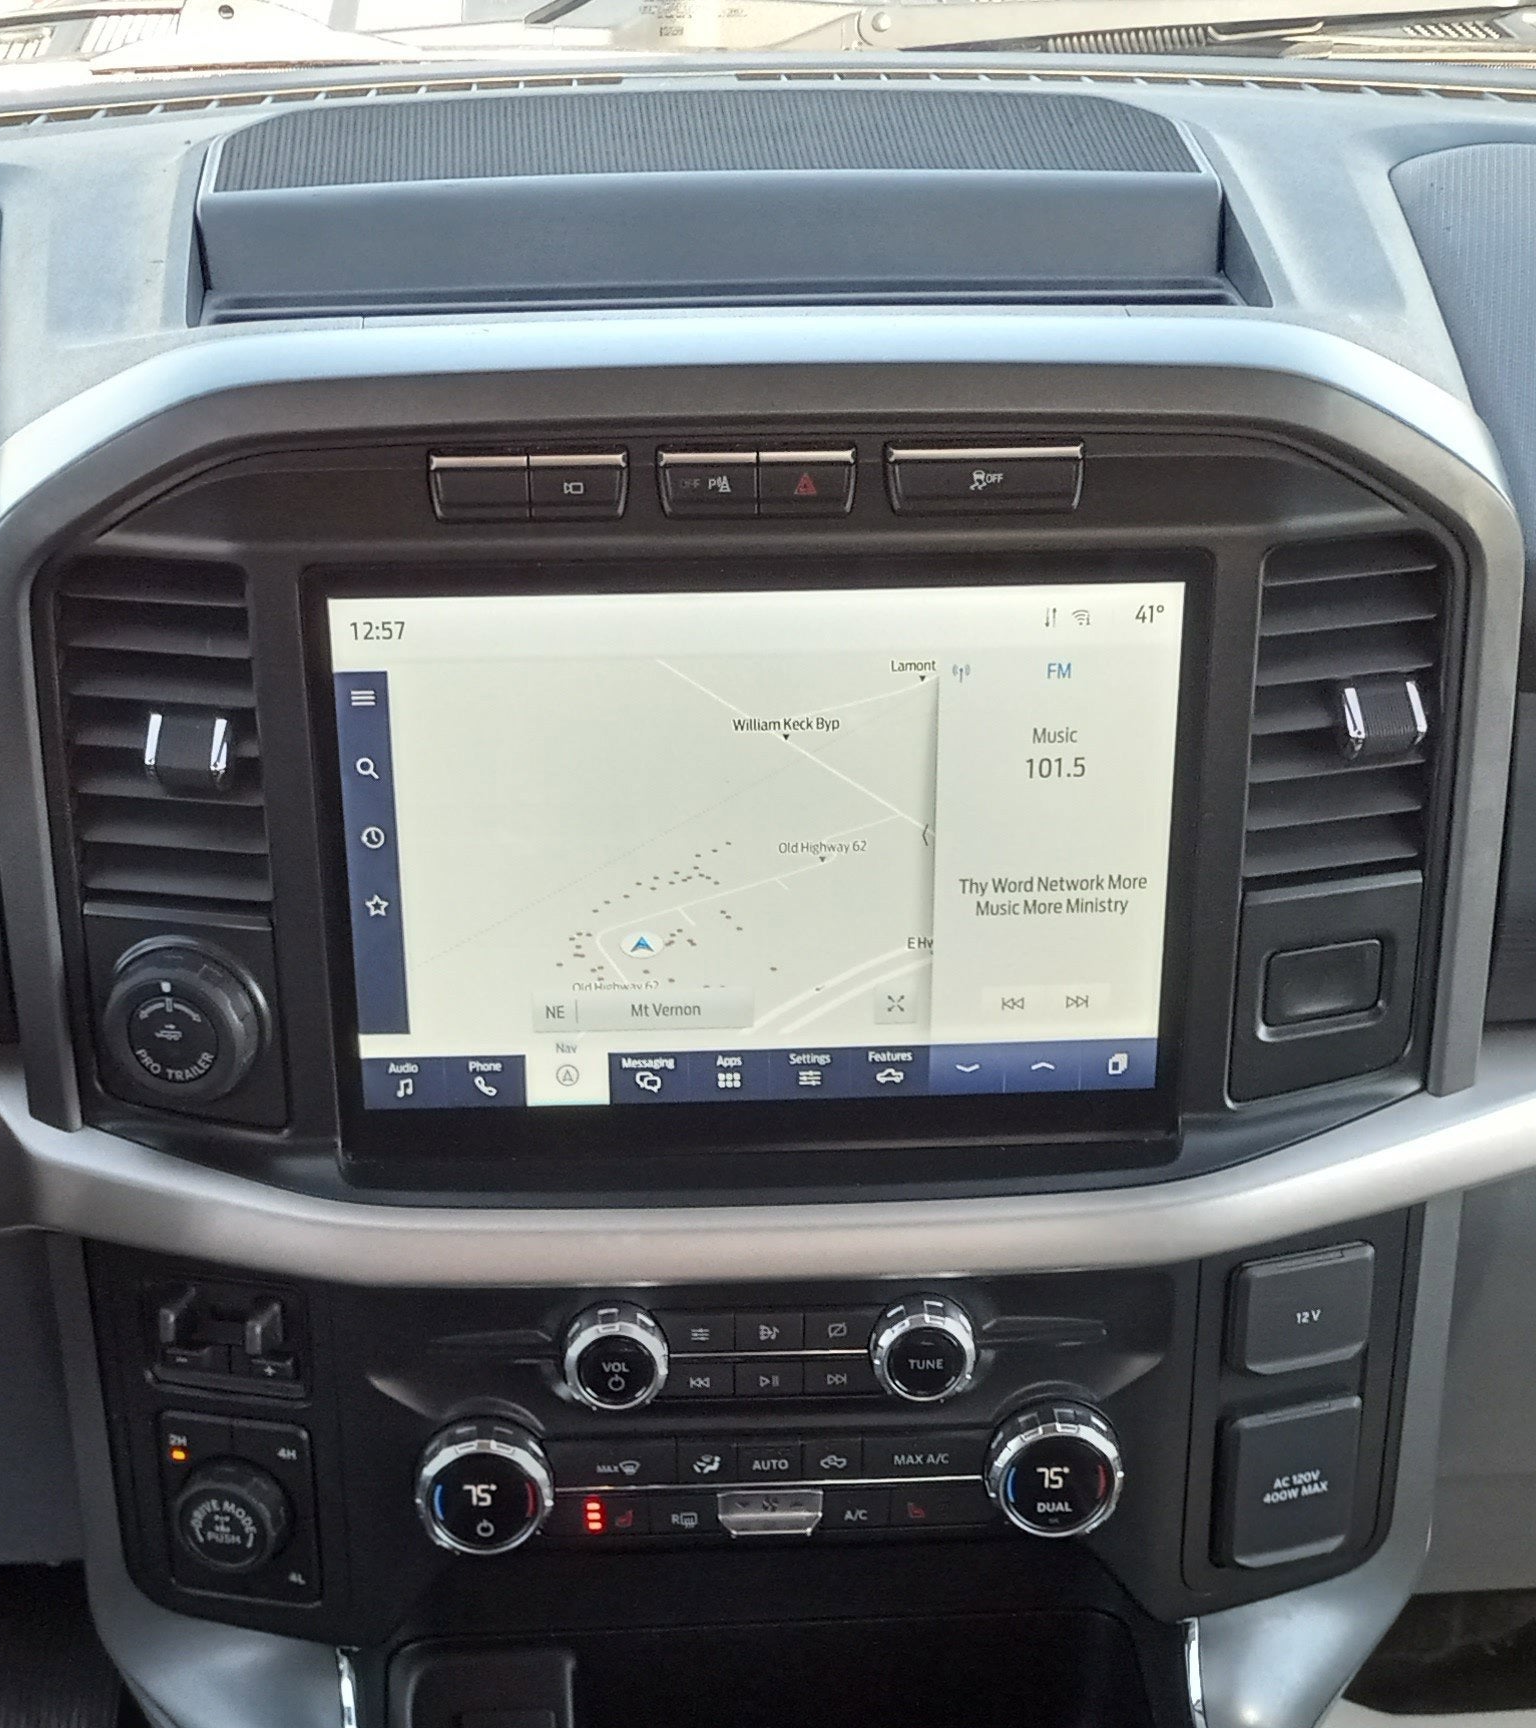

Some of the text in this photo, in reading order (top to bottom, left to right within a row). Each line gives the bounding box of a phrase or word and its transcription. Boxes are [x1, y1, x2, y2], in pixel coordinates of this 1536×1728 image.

[986, 473, 1004, 484] OFF
[1134, 604, 1166, 624] 41°
[350, 621, 405, 640] 12:57
[890, 660, 937, 673] Lamont
[1046, 662, 1073, 680] FM
[733, 717, 840, 733] William Keck Byp
[1032, 727, 1078, 745] Music
[1025, 757, 1086, 780] 101.5
[778, 841, 867, 856] Old Highway 62
[959, 874, 1148, 897] Thy Word Network More
[975, 896, 1129, 916] Music More Ministry
[907, 936, 916, 949] E
[545, 1005, 565, 1020] NE
[630, 1003, 702, 1018] Mt Vernon
[555, 1042, 577, 1054] Nav
[621, 1056, 675, 1070] Messaging
[716, 1055, 742, 1068] Apps
[789, 1052, 831, 1066] Settings
[868, 1050, 913, 1063] Features
[135, 1048, 215, 1080] PRO TRAILER
[388, 1062, 419, 1074] Audio
[468, 1060, 502, 1073] Phone
[1296, 1309, 1322, 1325] 12 V
[602, 1360, 630, 1374] VOL
[908, 1358, 944, 1371] TUNE
[276, 1448, 297, 1460] 4H
[893, 1452, 950, 1466] MAX A/C
[752, 1459, 789, 1471] AUTO
[1273, 1469, 1321, 1491] AC 120V
[1263, 1480, 1329, 1504] 400W MAX
[1037, 1502, 1073, 1514] DUAL
[190, 1499, 257, 1534] DRIVE MODE
[844, 1509, 868, 1522] A/C
[289, 1572, 306, 1585] 4L
